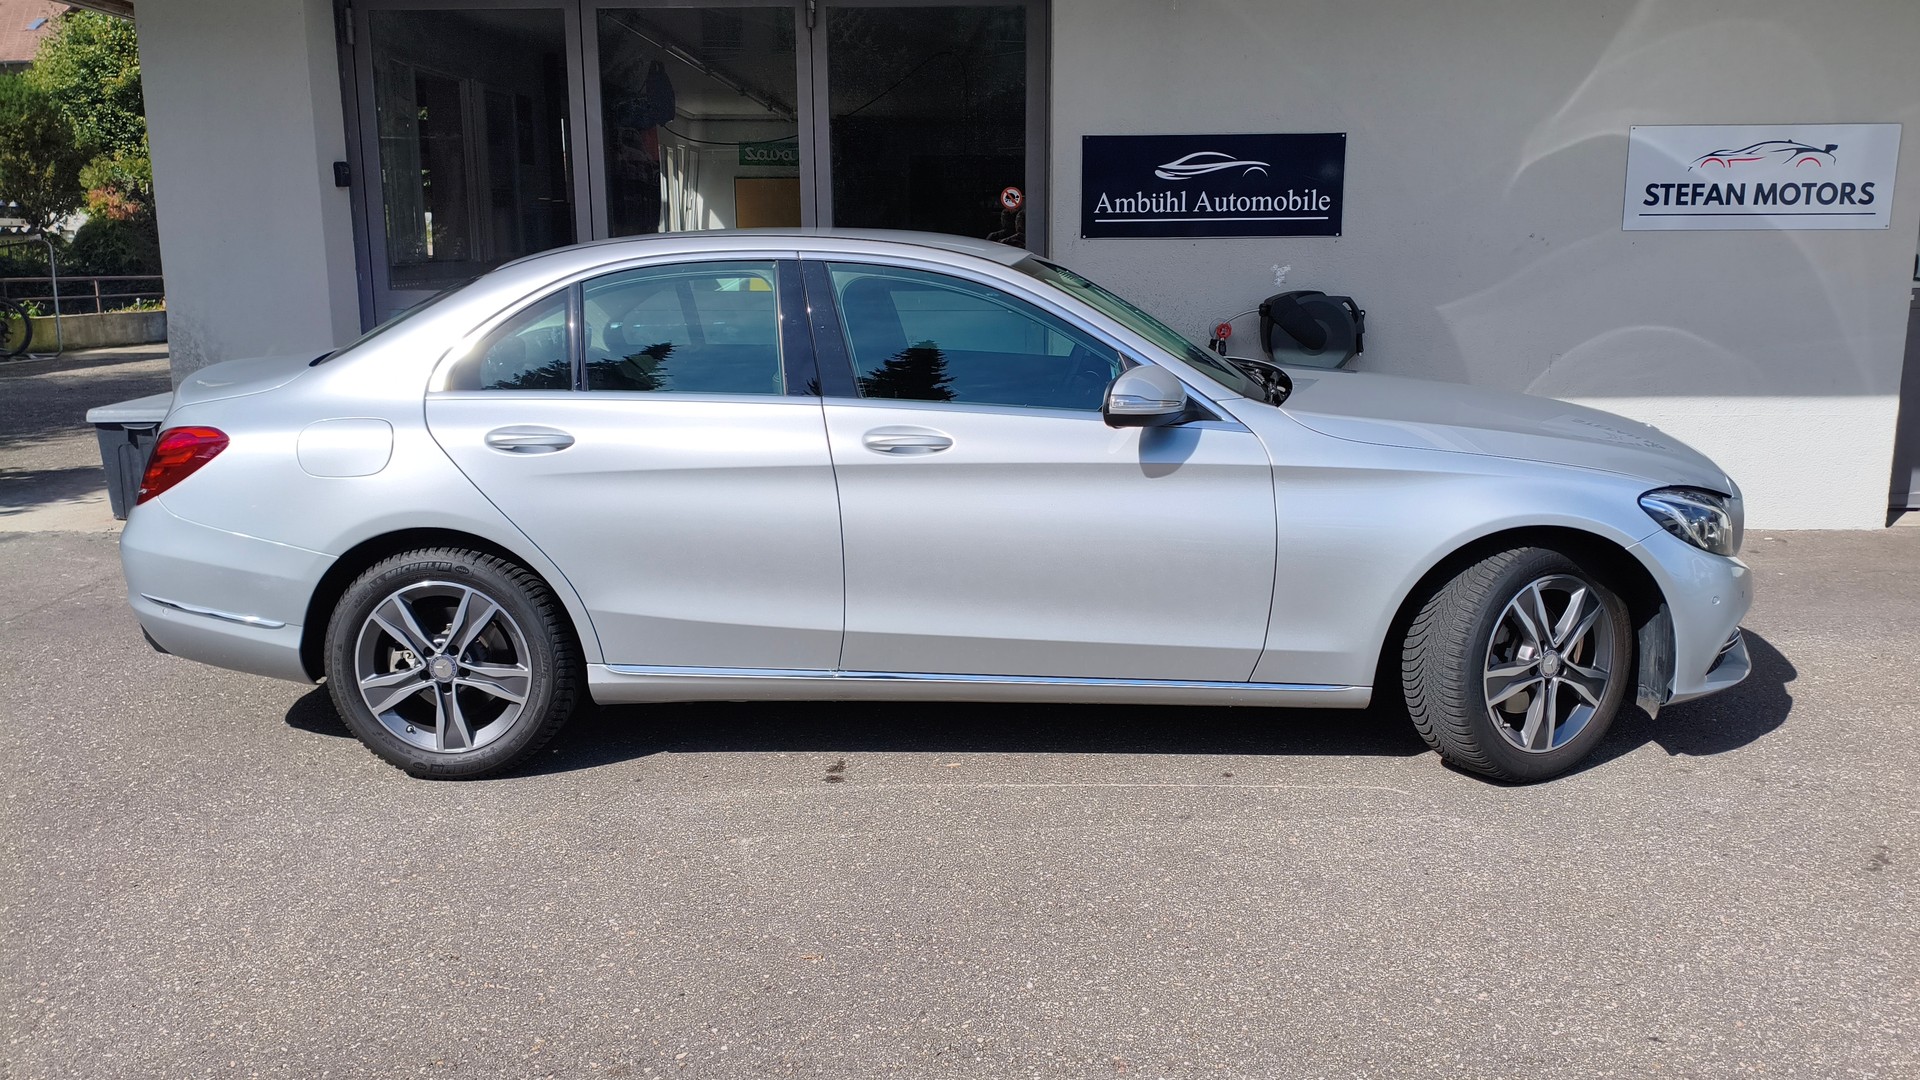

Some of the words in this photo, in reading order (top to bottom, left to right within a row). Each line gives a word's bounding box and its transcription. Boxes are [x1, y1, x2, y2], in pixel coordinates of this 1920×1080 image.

[1093, 190, 1187, 214] Ambühl
[1193, 189, 1331, 213] Automobile
[1643, 183, 1746, 206] STEFAN
[1753, 182, 1876, 206] MOTORS
[385, 562, 452, 580] MICHELIN
